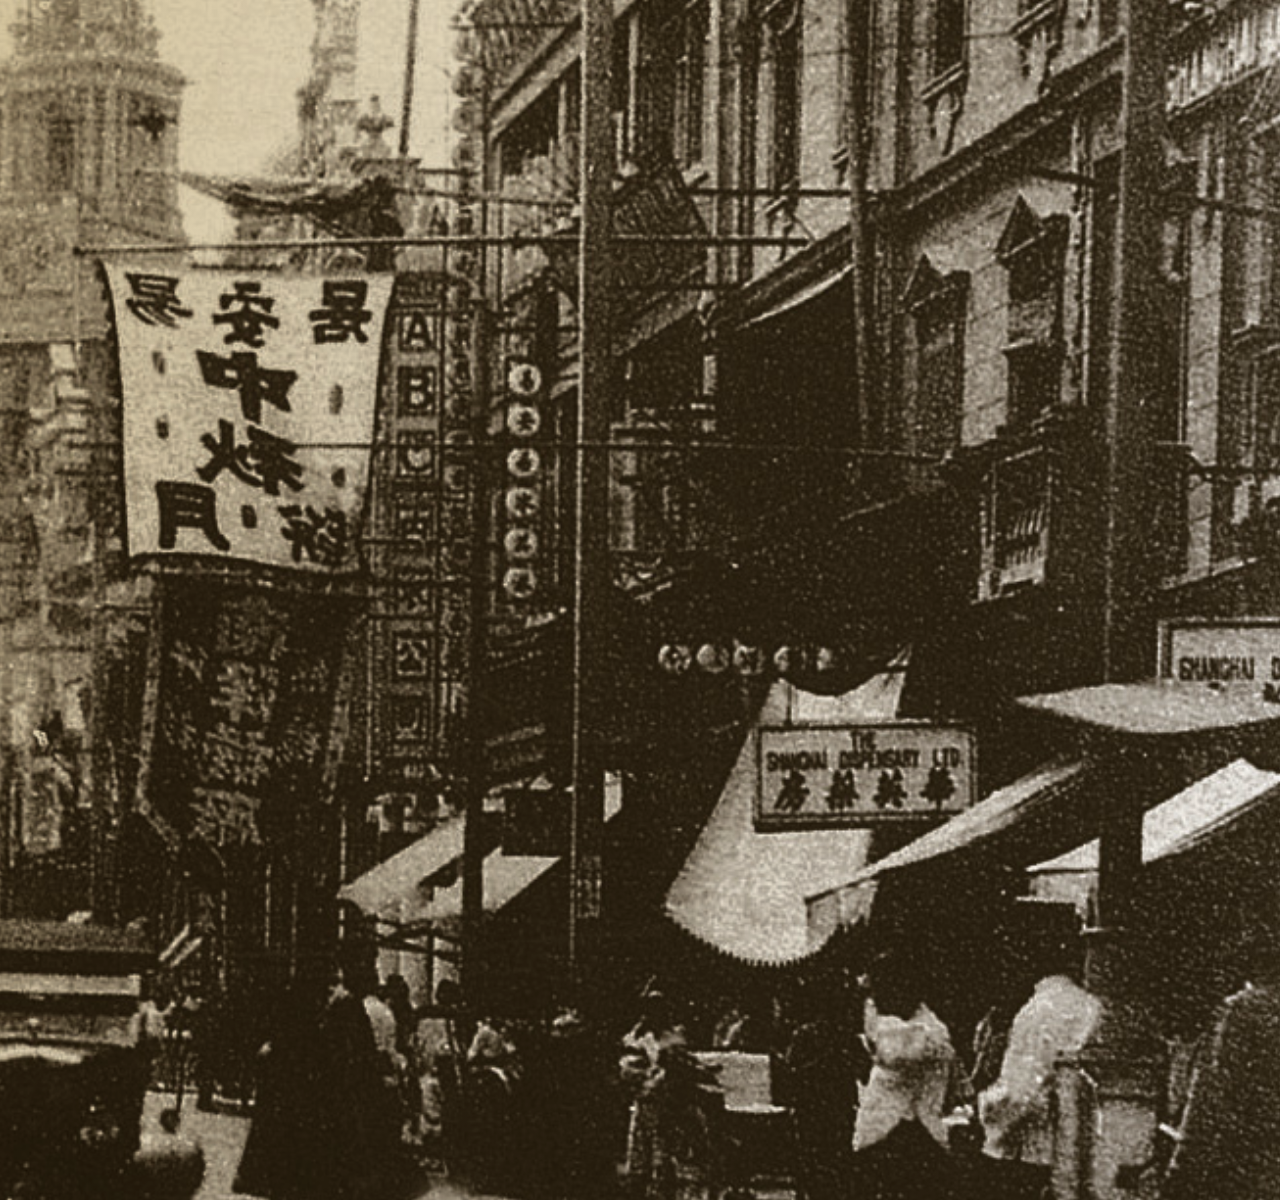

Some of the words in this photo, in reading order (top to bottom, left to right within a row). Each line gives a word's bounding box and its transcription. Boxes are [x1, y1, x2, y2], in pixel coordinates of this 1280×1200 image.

[1178, 656, 1255, 682] SHANGHAI
[766, 751, 828, 771] SHANGHAI
[840, 749, 920, 770] DISPENSARY
